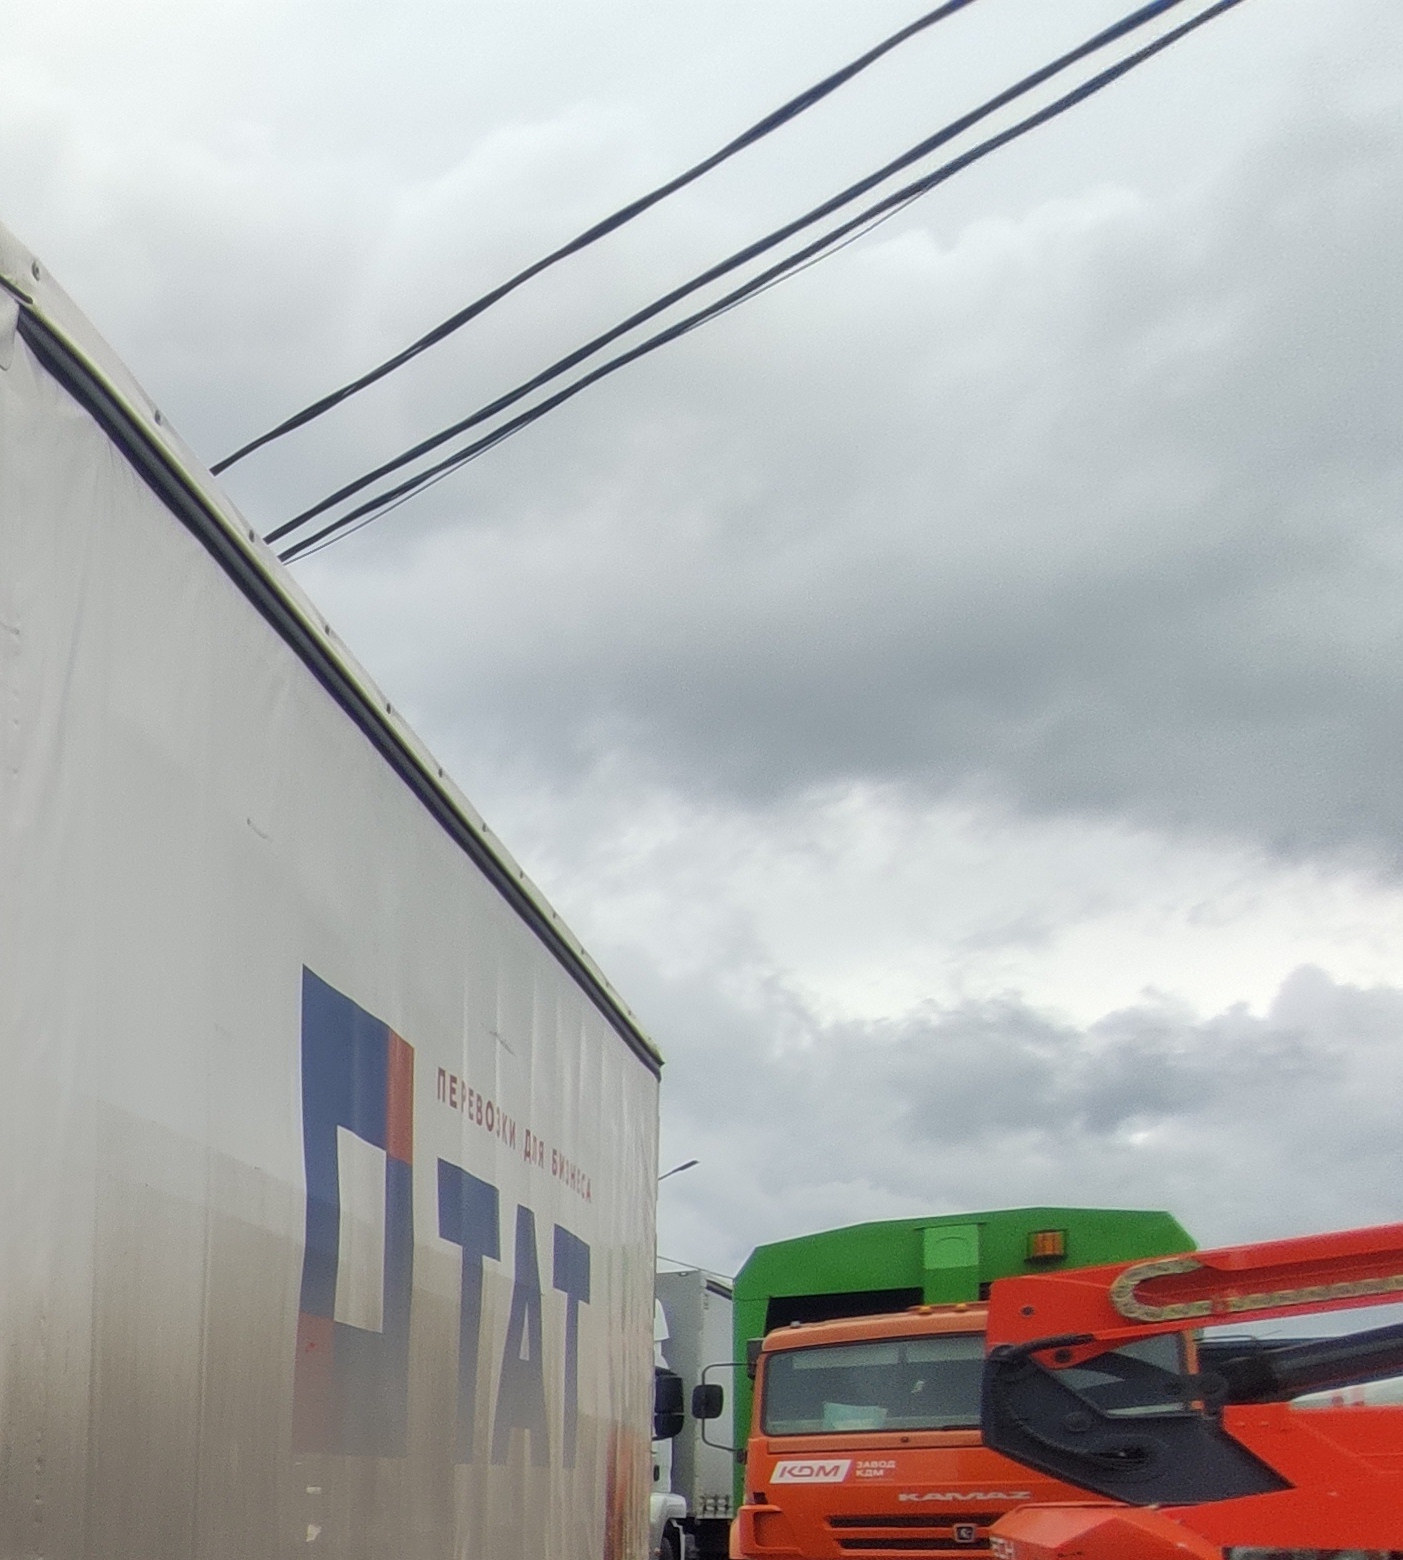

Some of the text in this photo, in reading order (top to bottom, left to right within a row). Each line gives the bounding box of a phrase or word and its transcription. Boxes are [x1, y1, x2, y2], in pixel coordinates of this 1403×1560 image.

[437, 1067, 591, 1203] ПЕРЕВОЗКИ ДЛЯ БИЗНЕСА
[855, 1459, 896, 1470] ЗАВОД
[855, 1468, 884, 1478] КДМ
[897, 1490, 1031, 1502] KAMAZ
